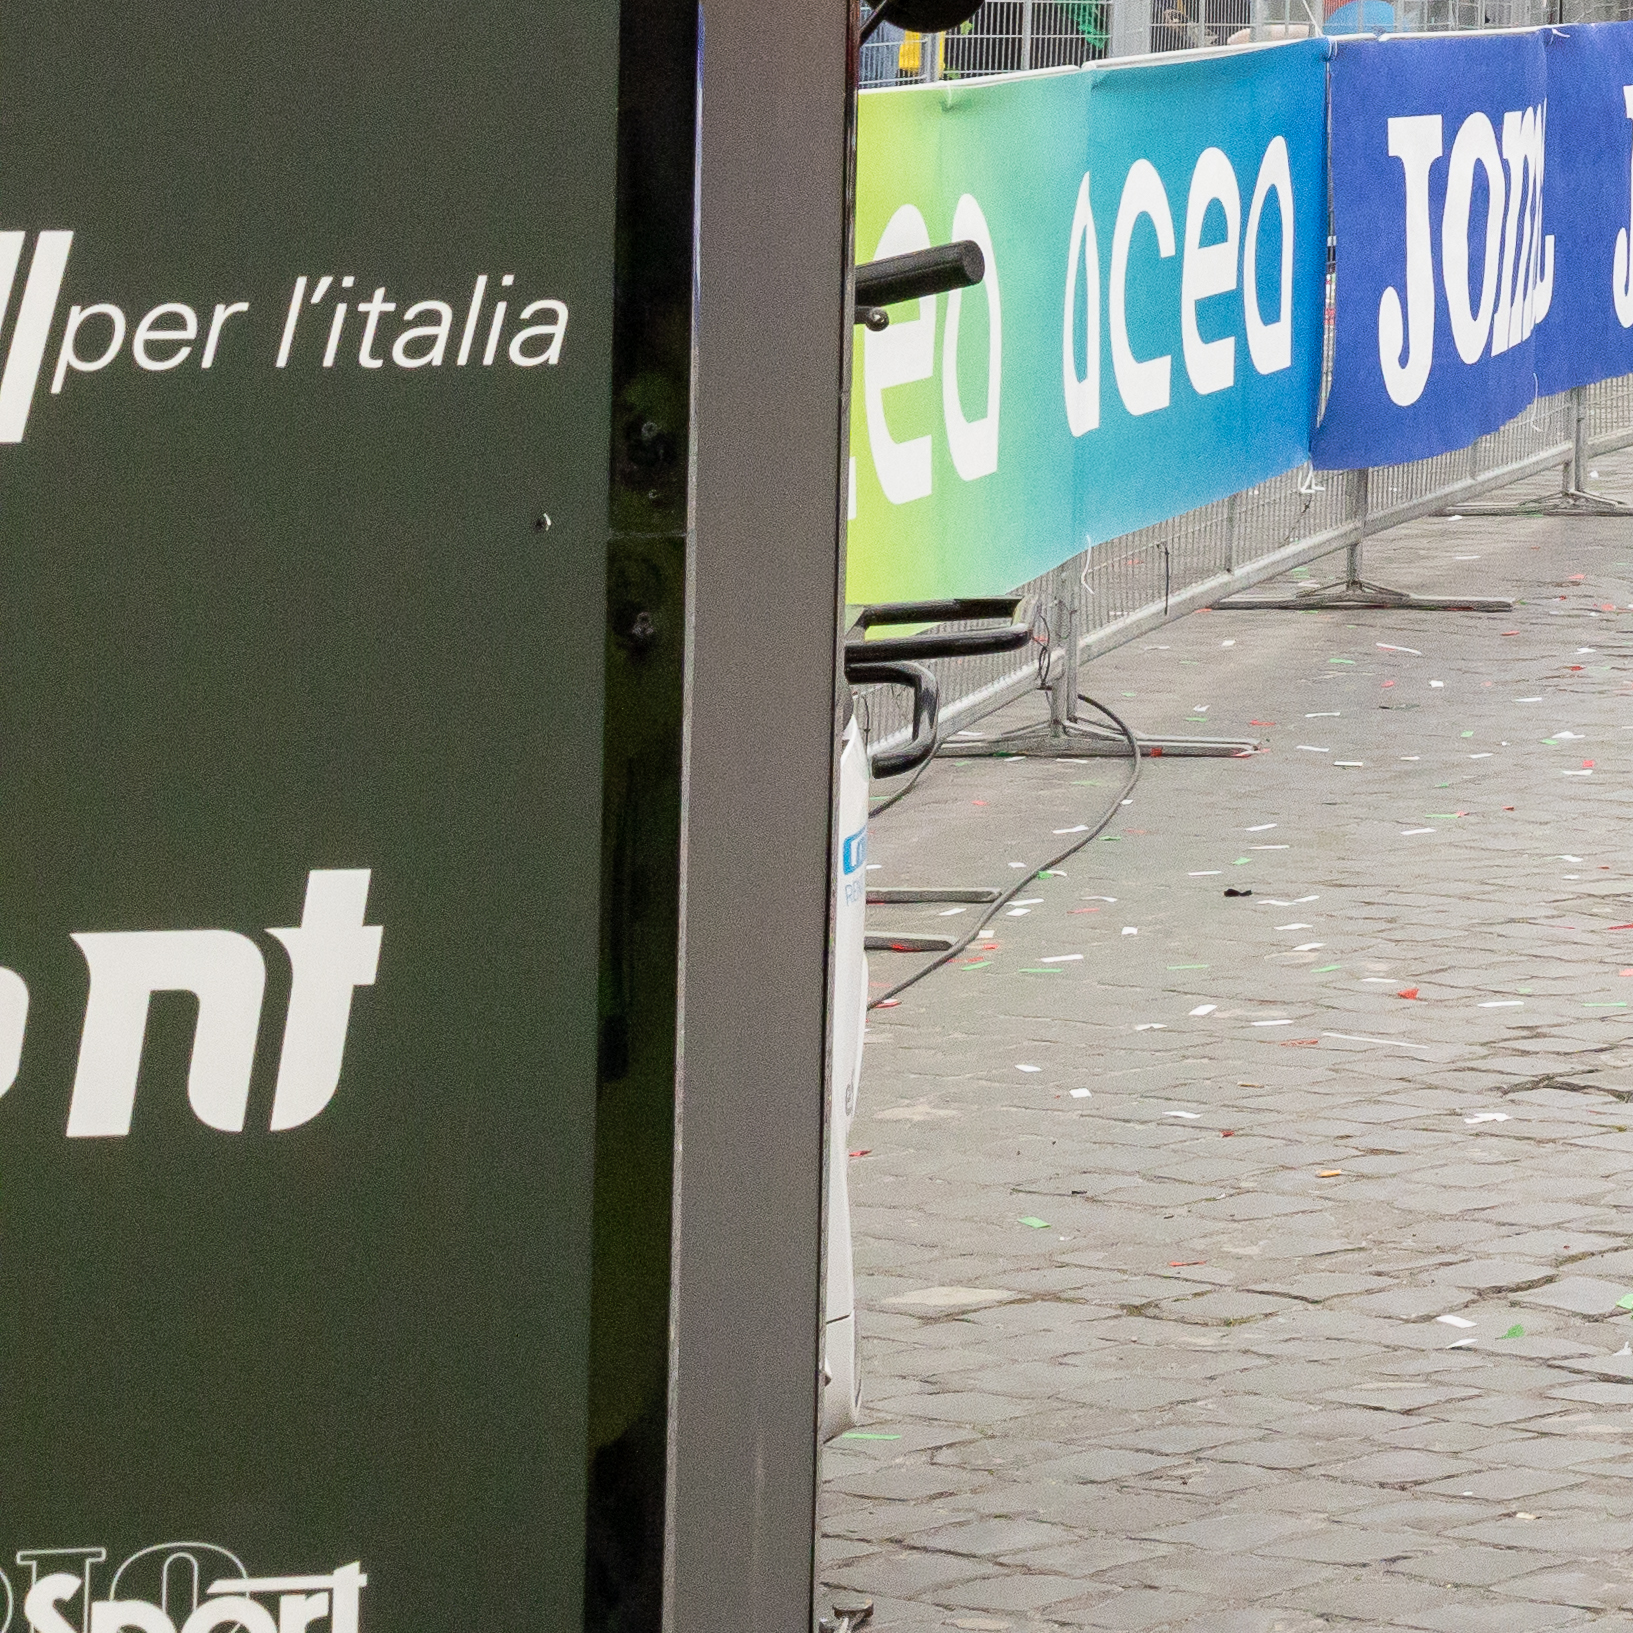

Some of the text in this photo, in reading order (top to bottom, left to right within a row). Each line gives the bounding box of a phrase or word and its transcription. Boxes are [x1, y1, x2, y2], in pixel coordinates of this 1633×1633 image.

[51, 300, 250, 394] per
[275, 273, 570, 369] l'italia
[1063, 135, 1294, 437] acea
